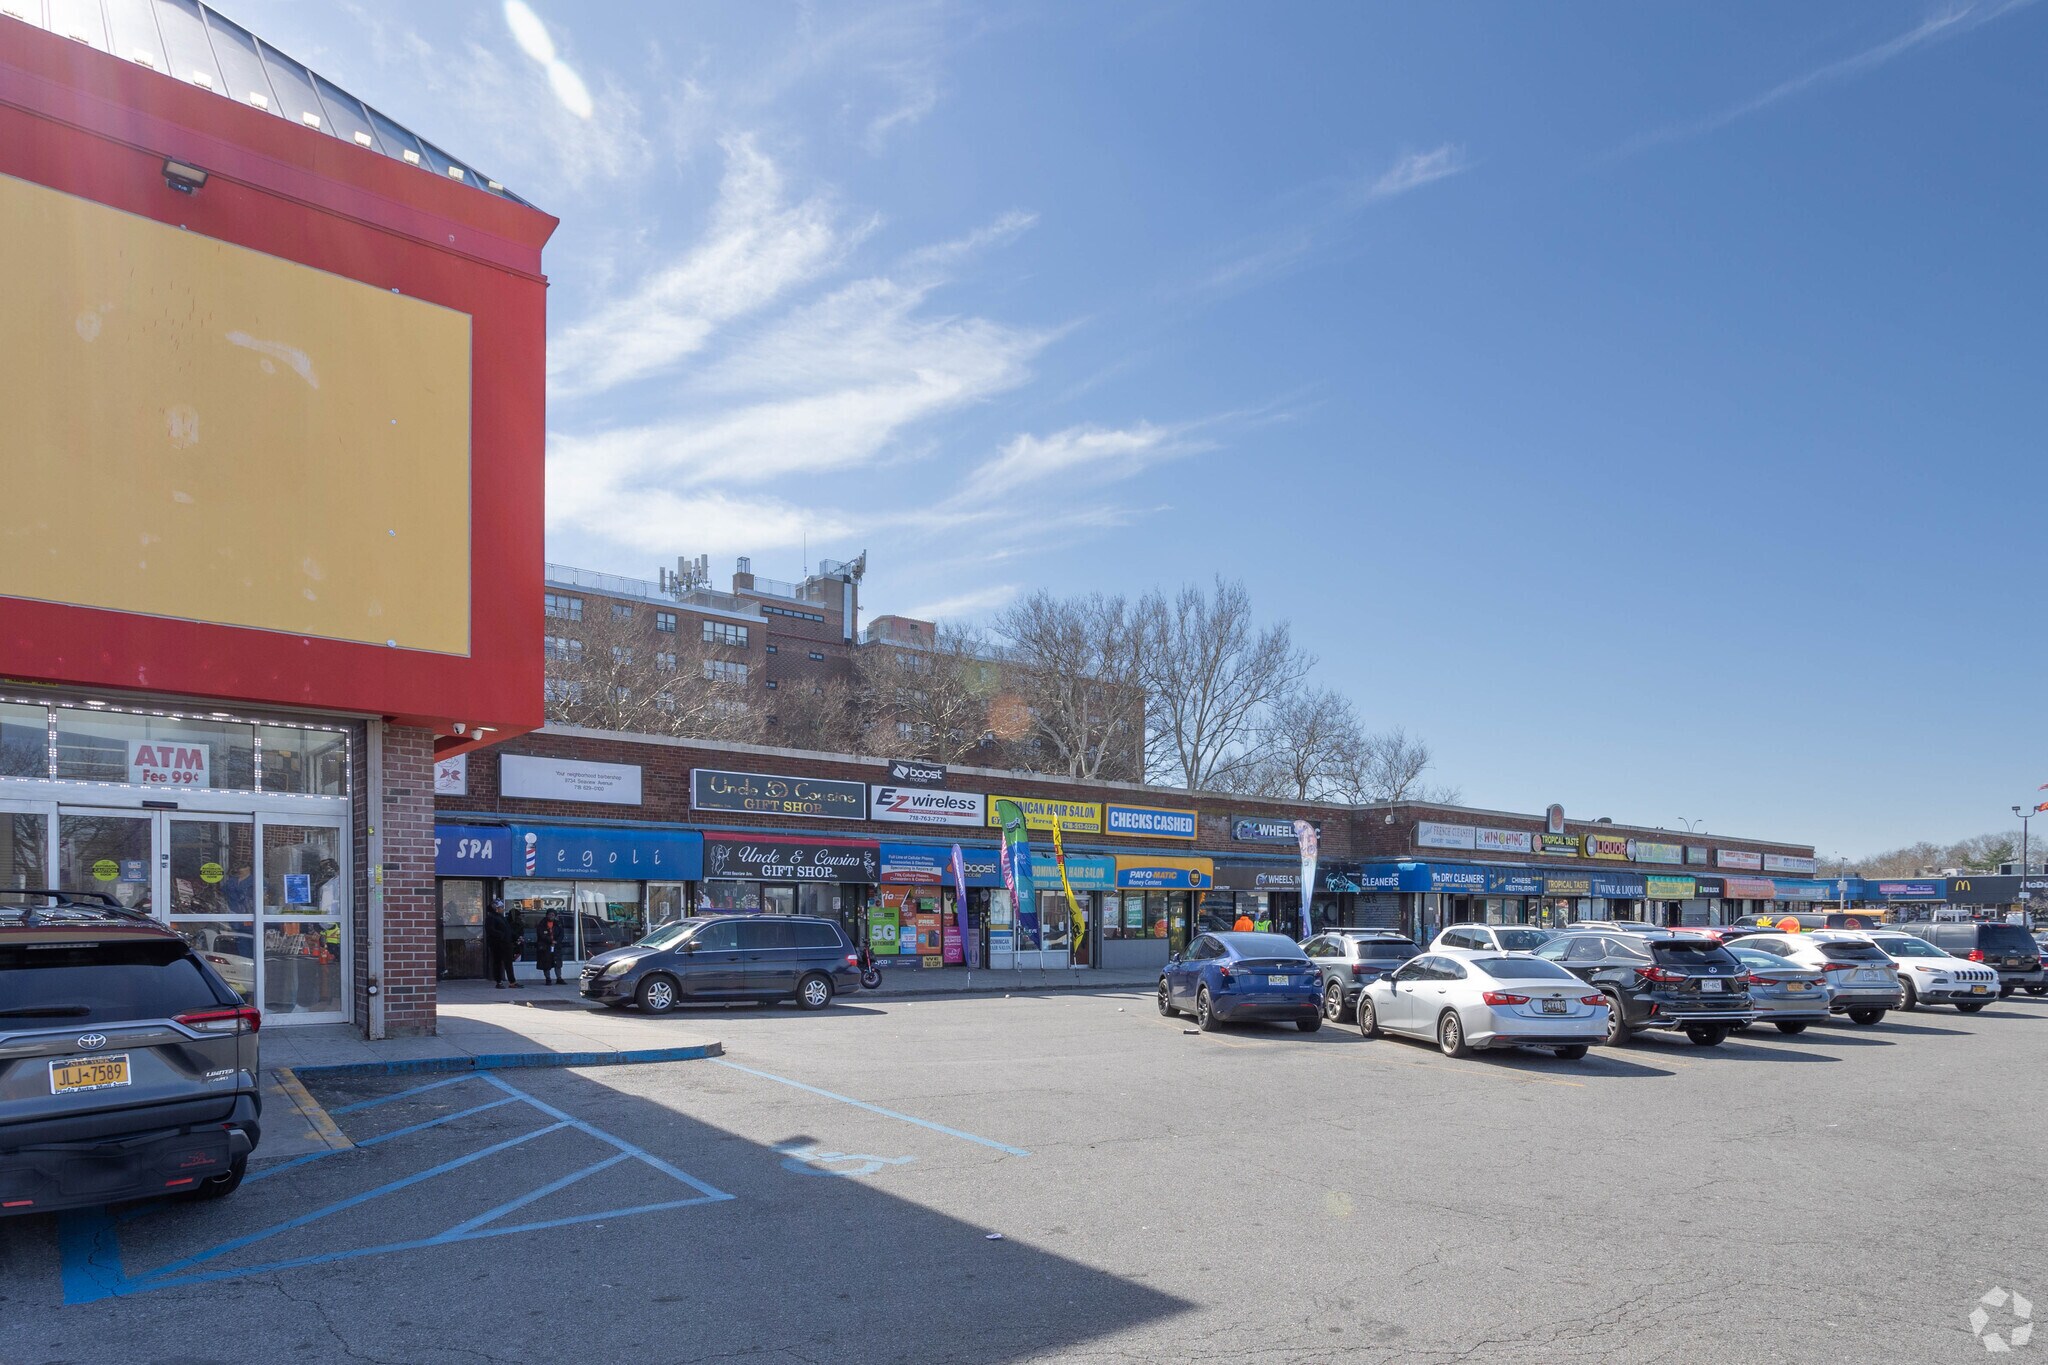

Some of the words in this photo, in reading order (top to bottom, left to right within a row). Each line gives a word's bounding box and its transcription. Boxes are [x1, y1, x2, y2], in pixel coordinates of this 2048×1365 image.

[134, 744, 204, 771] ATM
[143, 768, 168, 783] Fee
[172, 770, 200, 785] 99¢
[566, 771, 597, 779] neighborhood
[909, 766, 942, 780] boost
[710, 776, 759, 796] Uncle
[794, 782, 856, 804] Cousins
[744, 798, 780, 812] GIFT
[783, 800, 823, 814] SHOP
[875, 788, 910, 813] EZ
[911, 793, 976, 811] wireless
[1046, 803, 1067, 817] HAIR
[1069, 805, 1096, 819] SALON
[1110, 811, 1153, 829] CHECKS
[1153, 814, 1193, 833] CASHED
[1259, 823, 1298, 838] WHEELS
[1542, 834, 1565, 845] TROPICAL
[1565, 837, 1580, 846] TASTE
[457, 838, 493, 859] SPA
[1597, 841, 1626, 855] LIQUOR
[738, 845, 780, 863] Uncle
[789, 849, 805, 864] &
[814, 848, 860, 866] Cousins
[761, 865, 794, 877] GIFT
[796, 866, 833, 878] SHOP
[964, 862, 996, 874] boost
[1069, 866, 1084, 878] HAIR
[1085, 867, 1105, 878] SALON
[1128, 879, 1144, 887] Money
[1361, 877, 1399, 887] CLEANERS
[1441, 873, 1453, 882] DRY
[1454, 874, 1485, 883] CLEANERS
[1511, 876, 1532, 884] CHINESE
[1547, 879, 1572, 889] TROPICAL
[1573, 880, 1589, 889] TASTE
[1504, 884, 1538, 892] RESTAURANT
[1600, 884, 1616, 895] WINE
[1616, 885, 1621, 894] &
[1621, 885, 1644, 897] LIQUOR
[872, 924, 896, 941] 5G
[59, 1068, 82, 1086] JLJ
[90, 1063, 122, 1082] 7589
